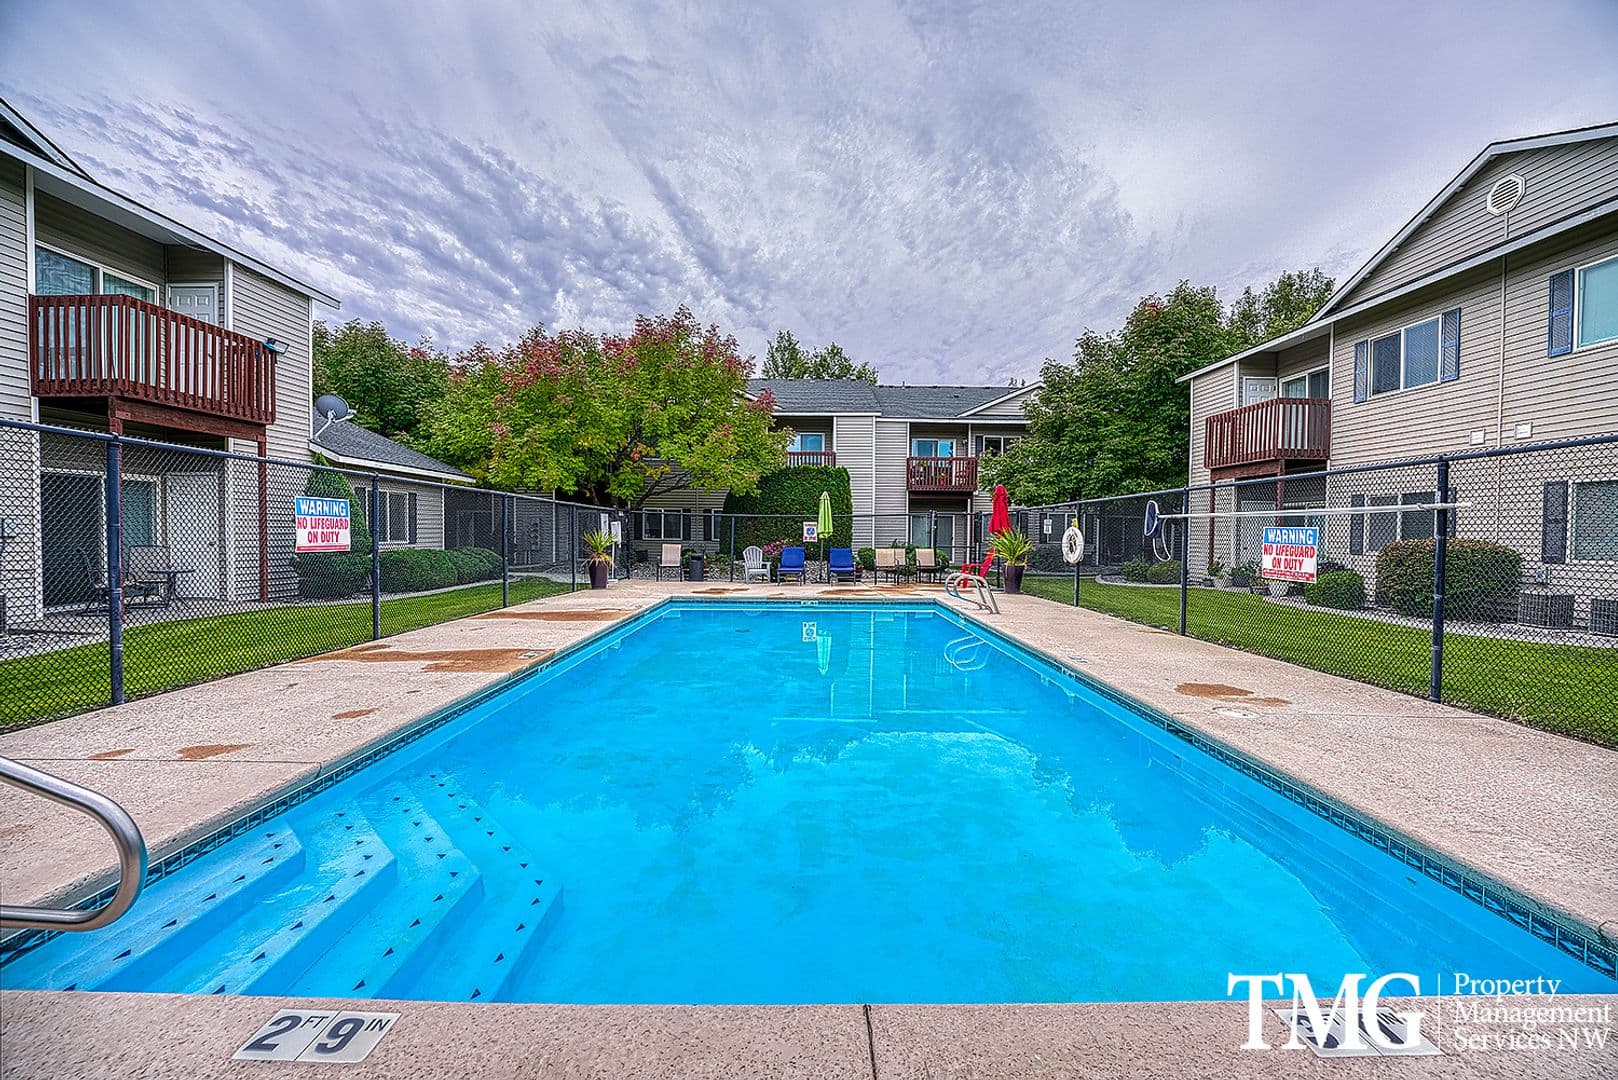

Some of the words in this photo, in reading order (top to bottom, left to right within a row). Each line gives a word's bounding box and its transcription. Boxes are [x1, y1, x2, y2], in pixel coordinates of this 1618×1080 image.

[300, 500, 346, 516] WARNING
[297, 517, 308, 530] NO
[310, 517, 349, 530] LIFEGUARD
[307, 531, 318, 543] ON
[320, 531, 340, 543] DUTY
[1267, 529, 1313, 544] WARNING
[1264, 544, 1274, 556] NO
[1276, 544, 1315, 558] LIFEGUARD
[1272, 557, 1282, 569] ON
[1284, 558, 1304, 570] DUTY
[299, 1015, 330, 1029] FT
[363, 1018, 392, 1032] IN
[242, 1015, 302, 1052] 2
[314, 1017, 366, 1055] 9
